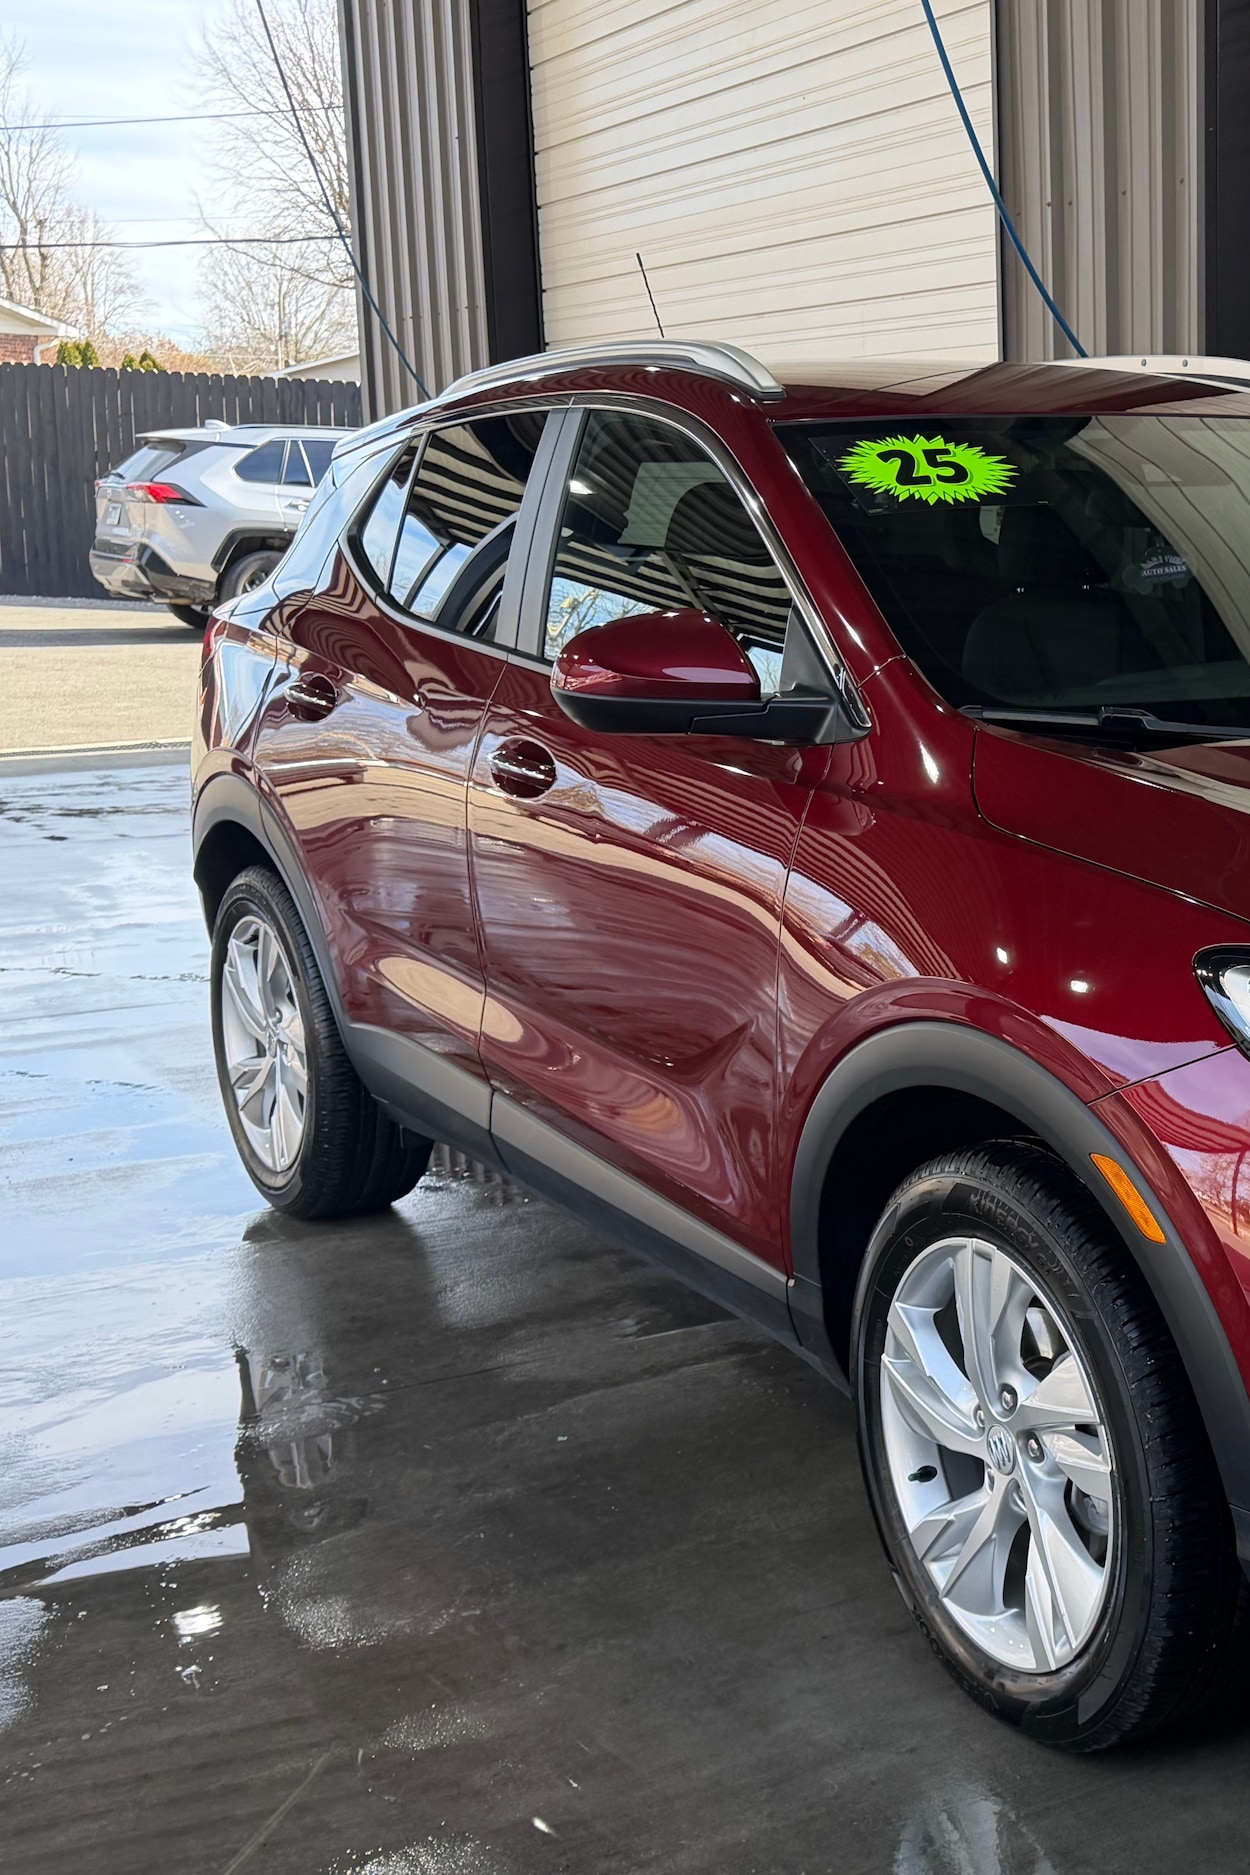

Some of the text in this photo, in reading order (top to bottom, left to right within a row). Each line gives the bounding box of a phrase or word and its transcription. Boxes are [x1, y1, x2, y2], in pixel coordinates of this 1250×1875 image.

[876, 448, 970, 487] 25
[1142, 565, 1187, 577] AUTO SALES
